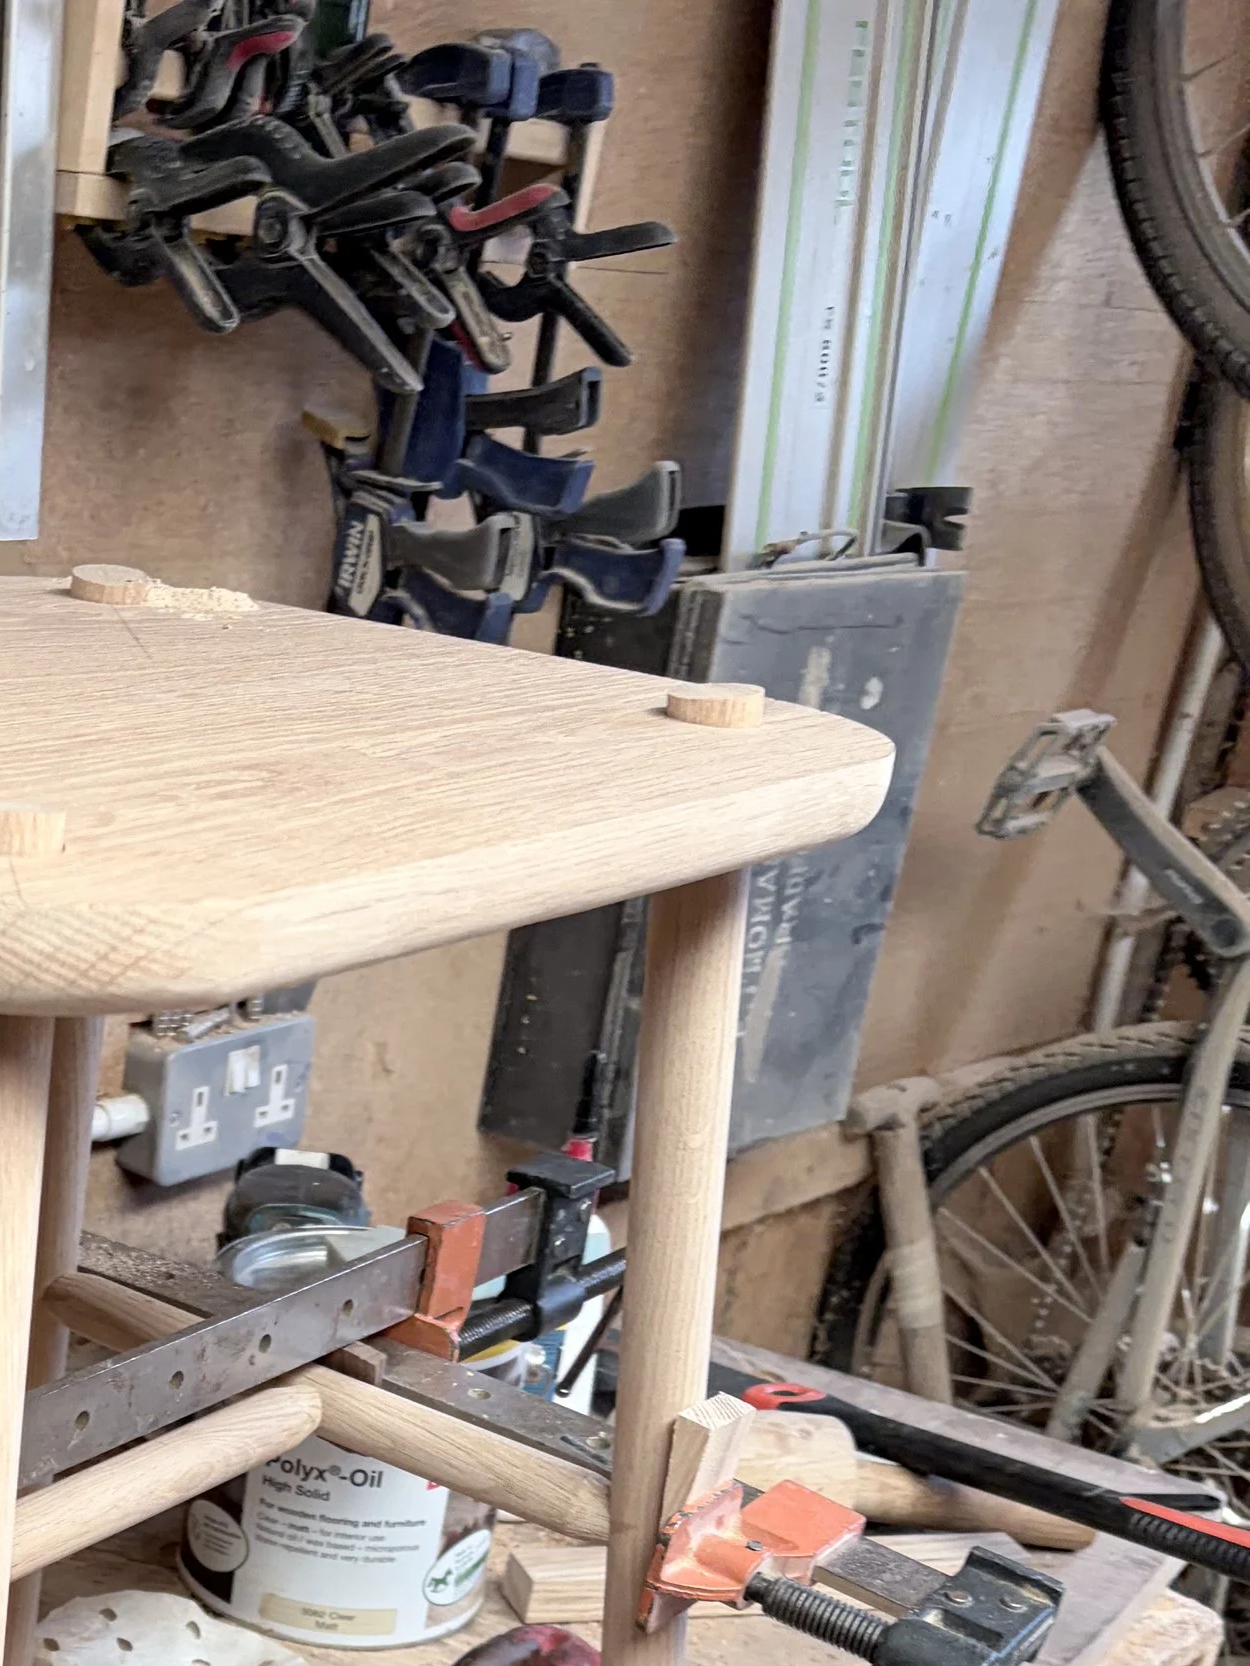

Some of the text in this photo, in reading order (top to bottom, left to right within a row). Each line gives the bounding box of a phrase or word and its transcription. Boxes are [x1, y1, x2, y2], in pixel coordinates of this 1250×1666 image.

[337, 520, 365, 589] IRWIN
[262, 1475, 331, 1501] High Solid
[362, 1520, 382, 1529] and
